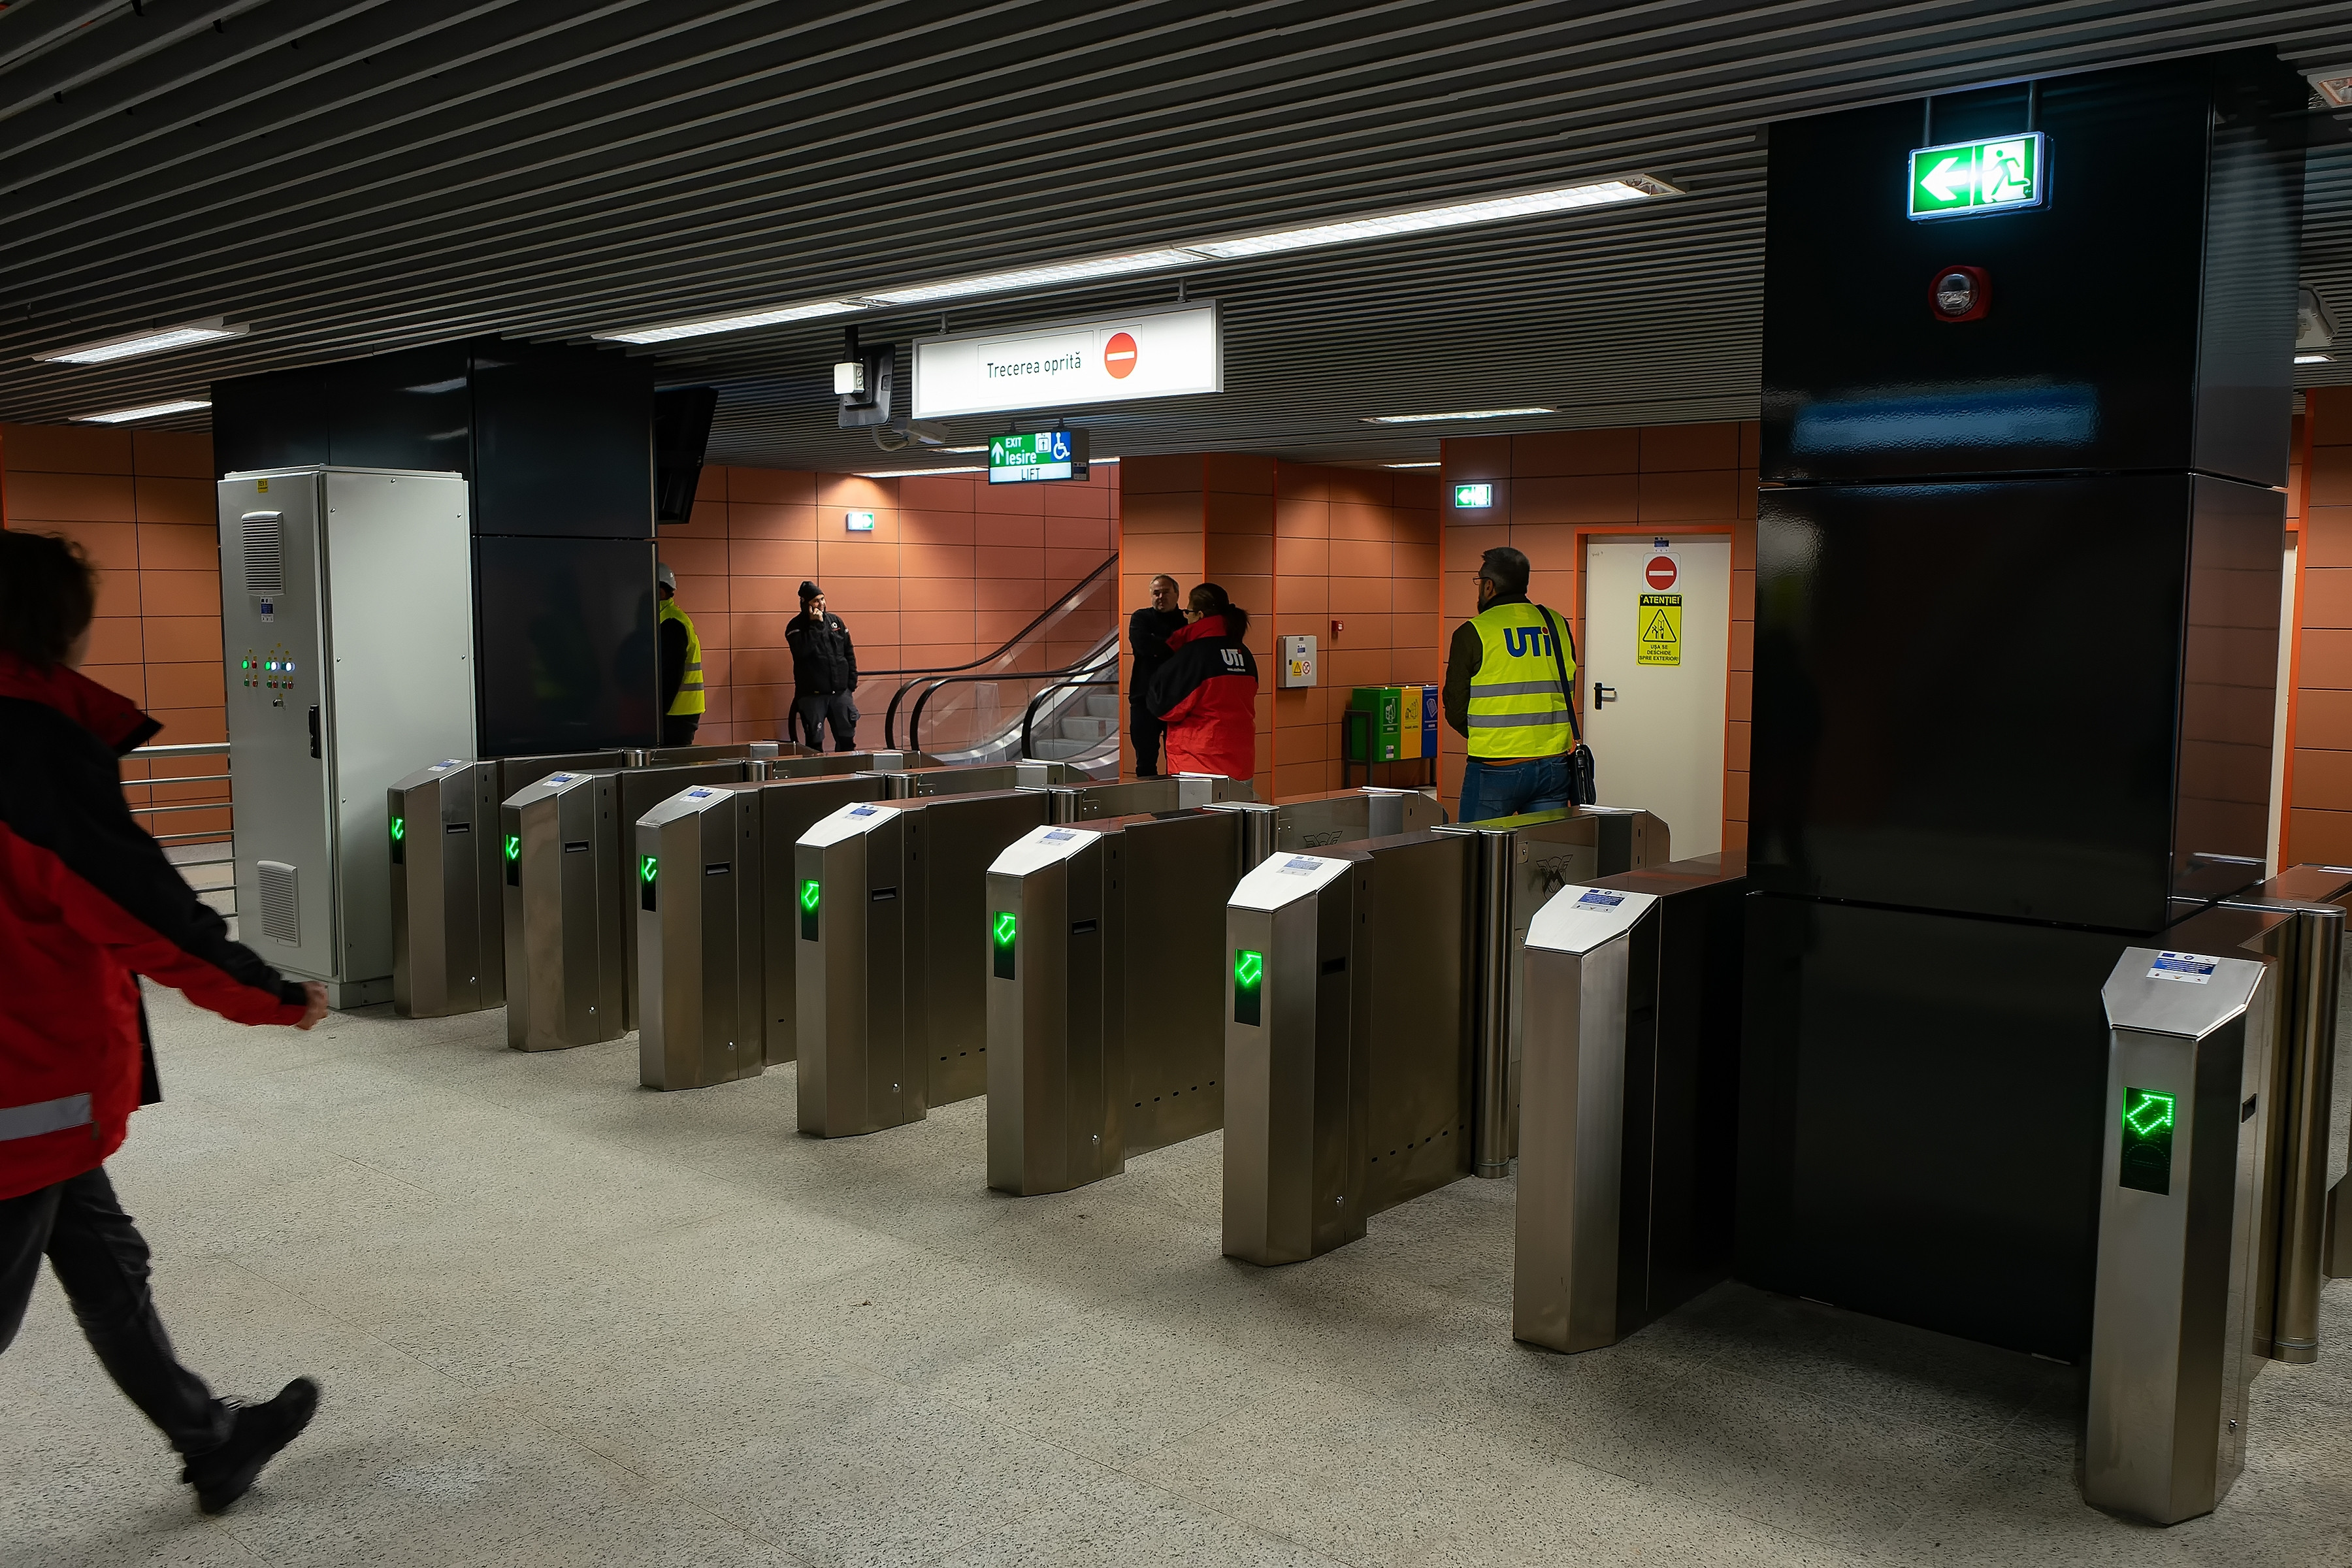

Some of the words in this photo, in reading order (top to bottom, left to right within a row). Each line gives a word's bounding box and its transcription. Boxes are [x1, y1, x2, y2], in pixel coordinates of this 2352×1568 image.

[987, 361, 1039, 378] Trecerea
[1044, 351, 1081, 375] oprită
[1005, 437, 1022, 448] EXIT
[1021, 468, 1040, 480] LIFT
